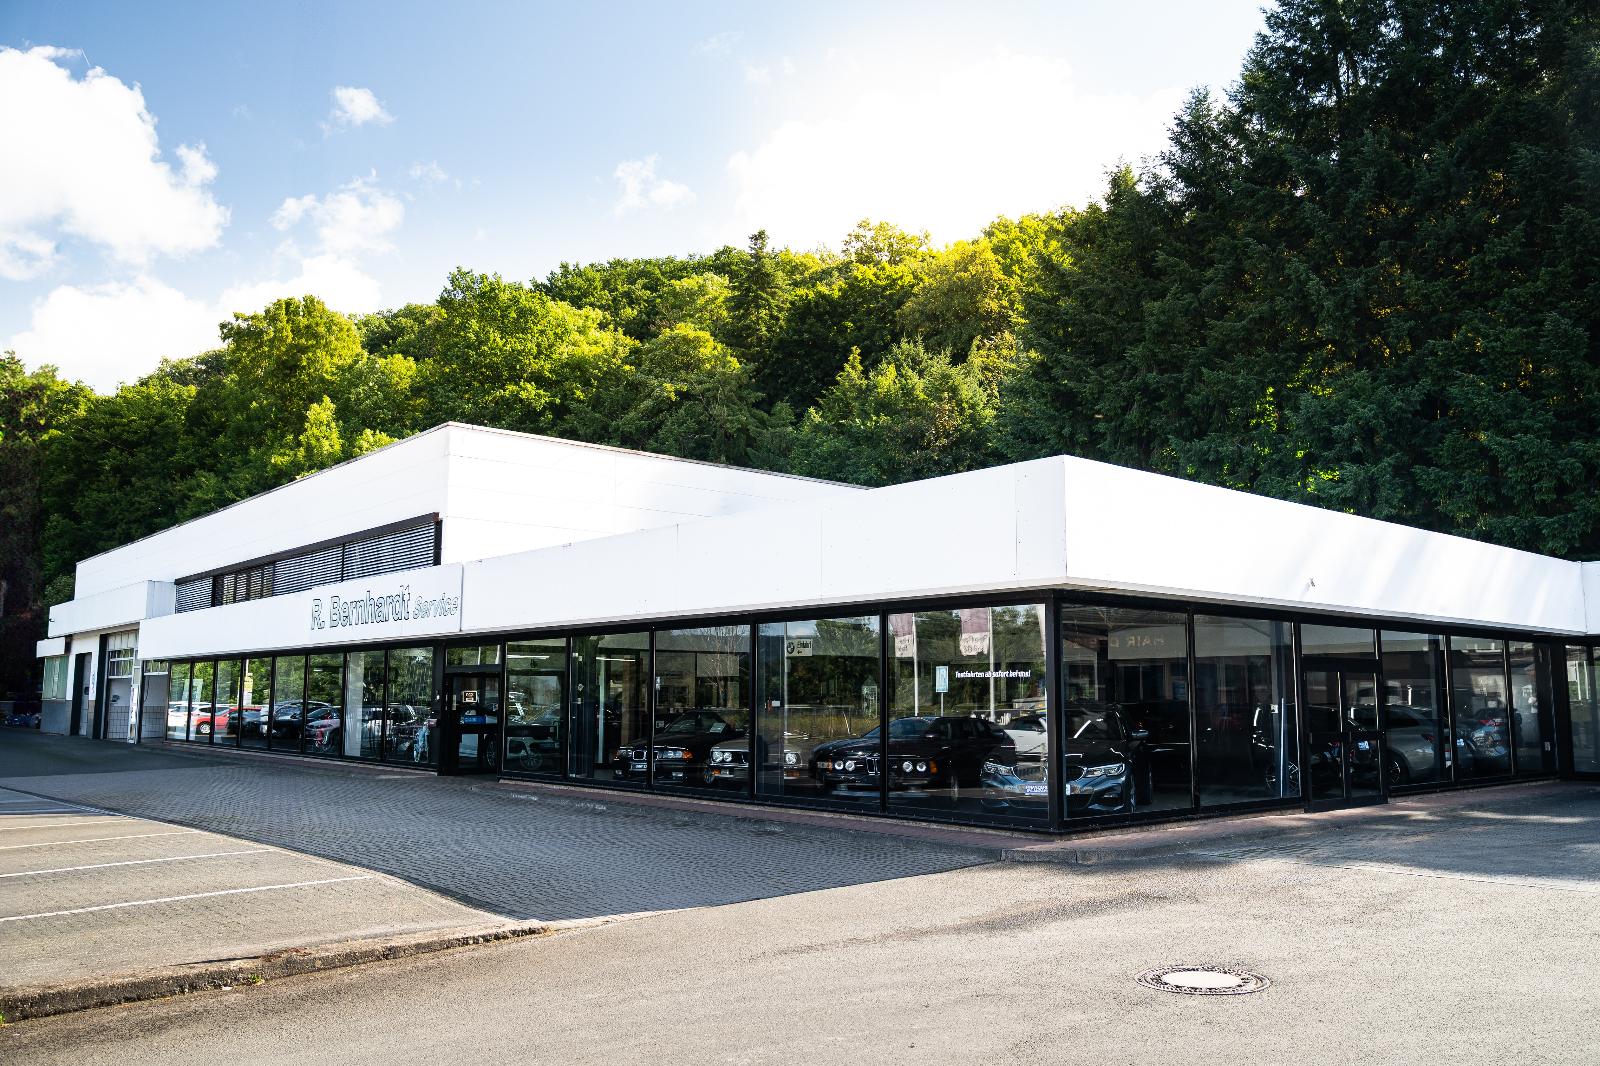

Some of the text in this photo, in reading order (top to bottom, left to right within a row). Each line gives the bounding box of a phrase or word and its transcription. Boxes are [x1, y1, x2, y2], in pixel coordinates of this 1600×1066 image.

[311, 584, 460, 630] R. Bernhardt Service
